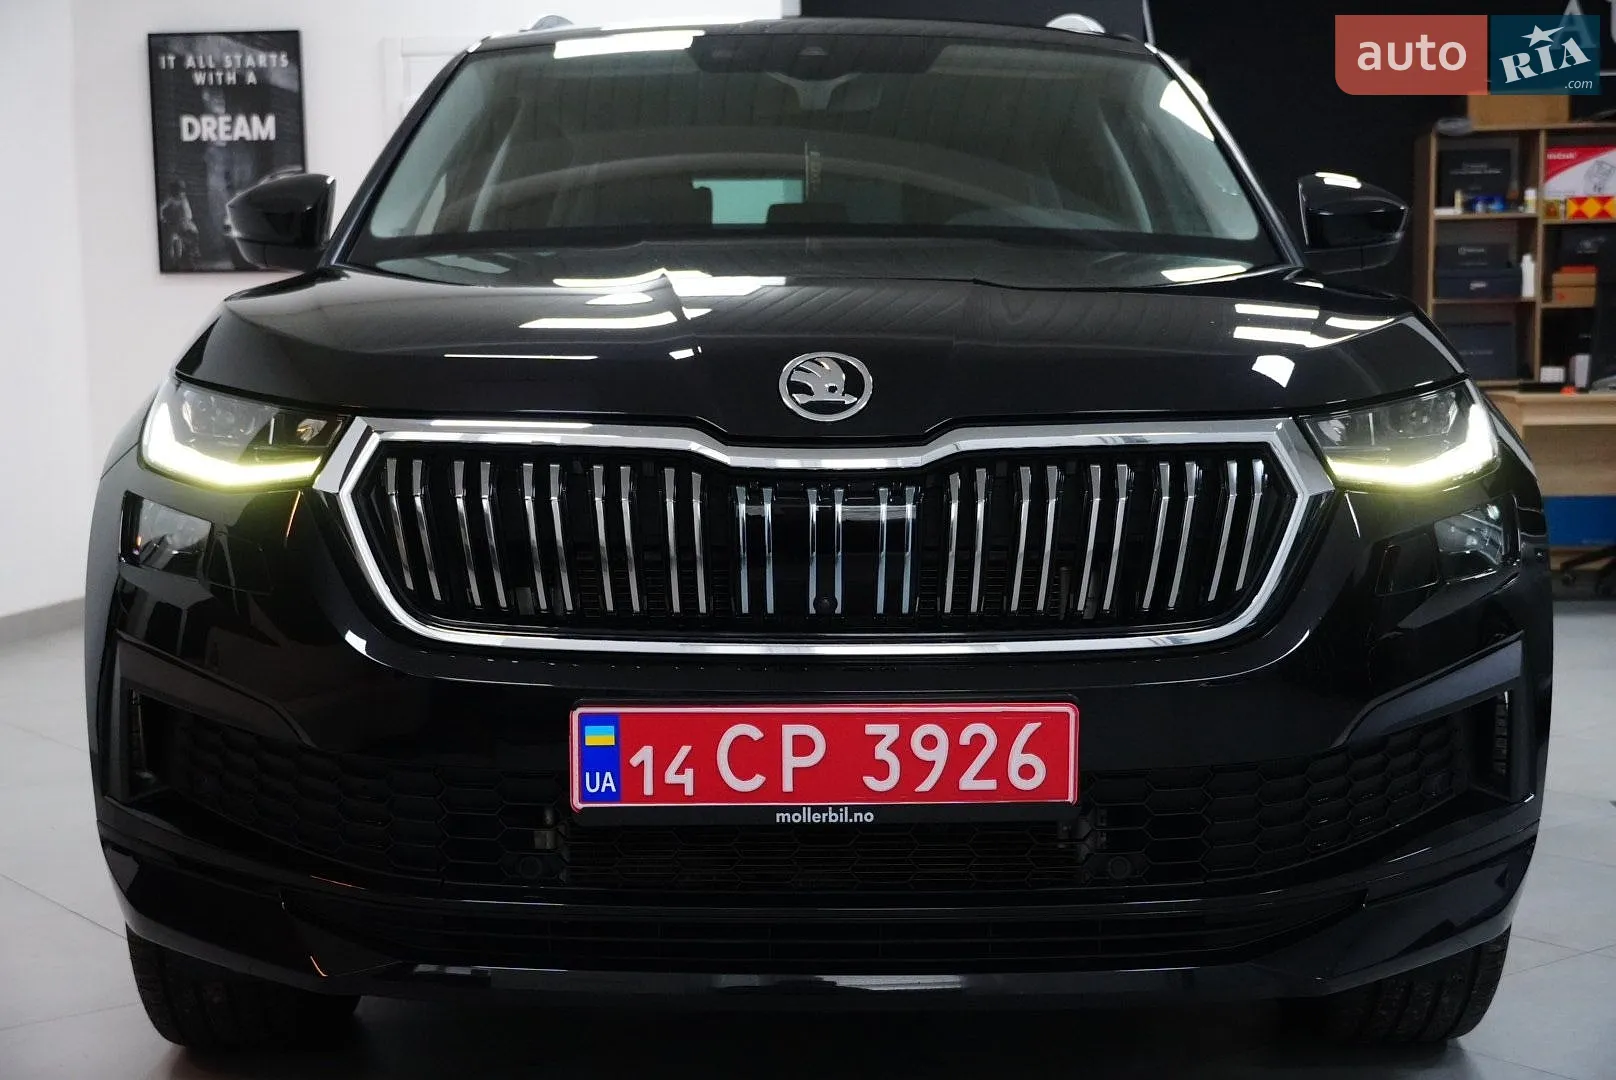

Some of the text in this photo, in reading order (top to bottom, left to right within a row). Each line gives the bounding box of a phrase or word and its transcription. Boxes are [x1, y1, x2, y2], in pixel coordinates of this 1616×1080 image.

[159, 51, 289, 70] IT ALL STARTS
[193, 71, 257, 85] WITH A
[180, 114, 276, 142] DREAM
[629, 721, 1047, 796] 14 CP 3926
[585, 771, 616, 793] UA
[775, 806, 875, 823] mollerbil.no
